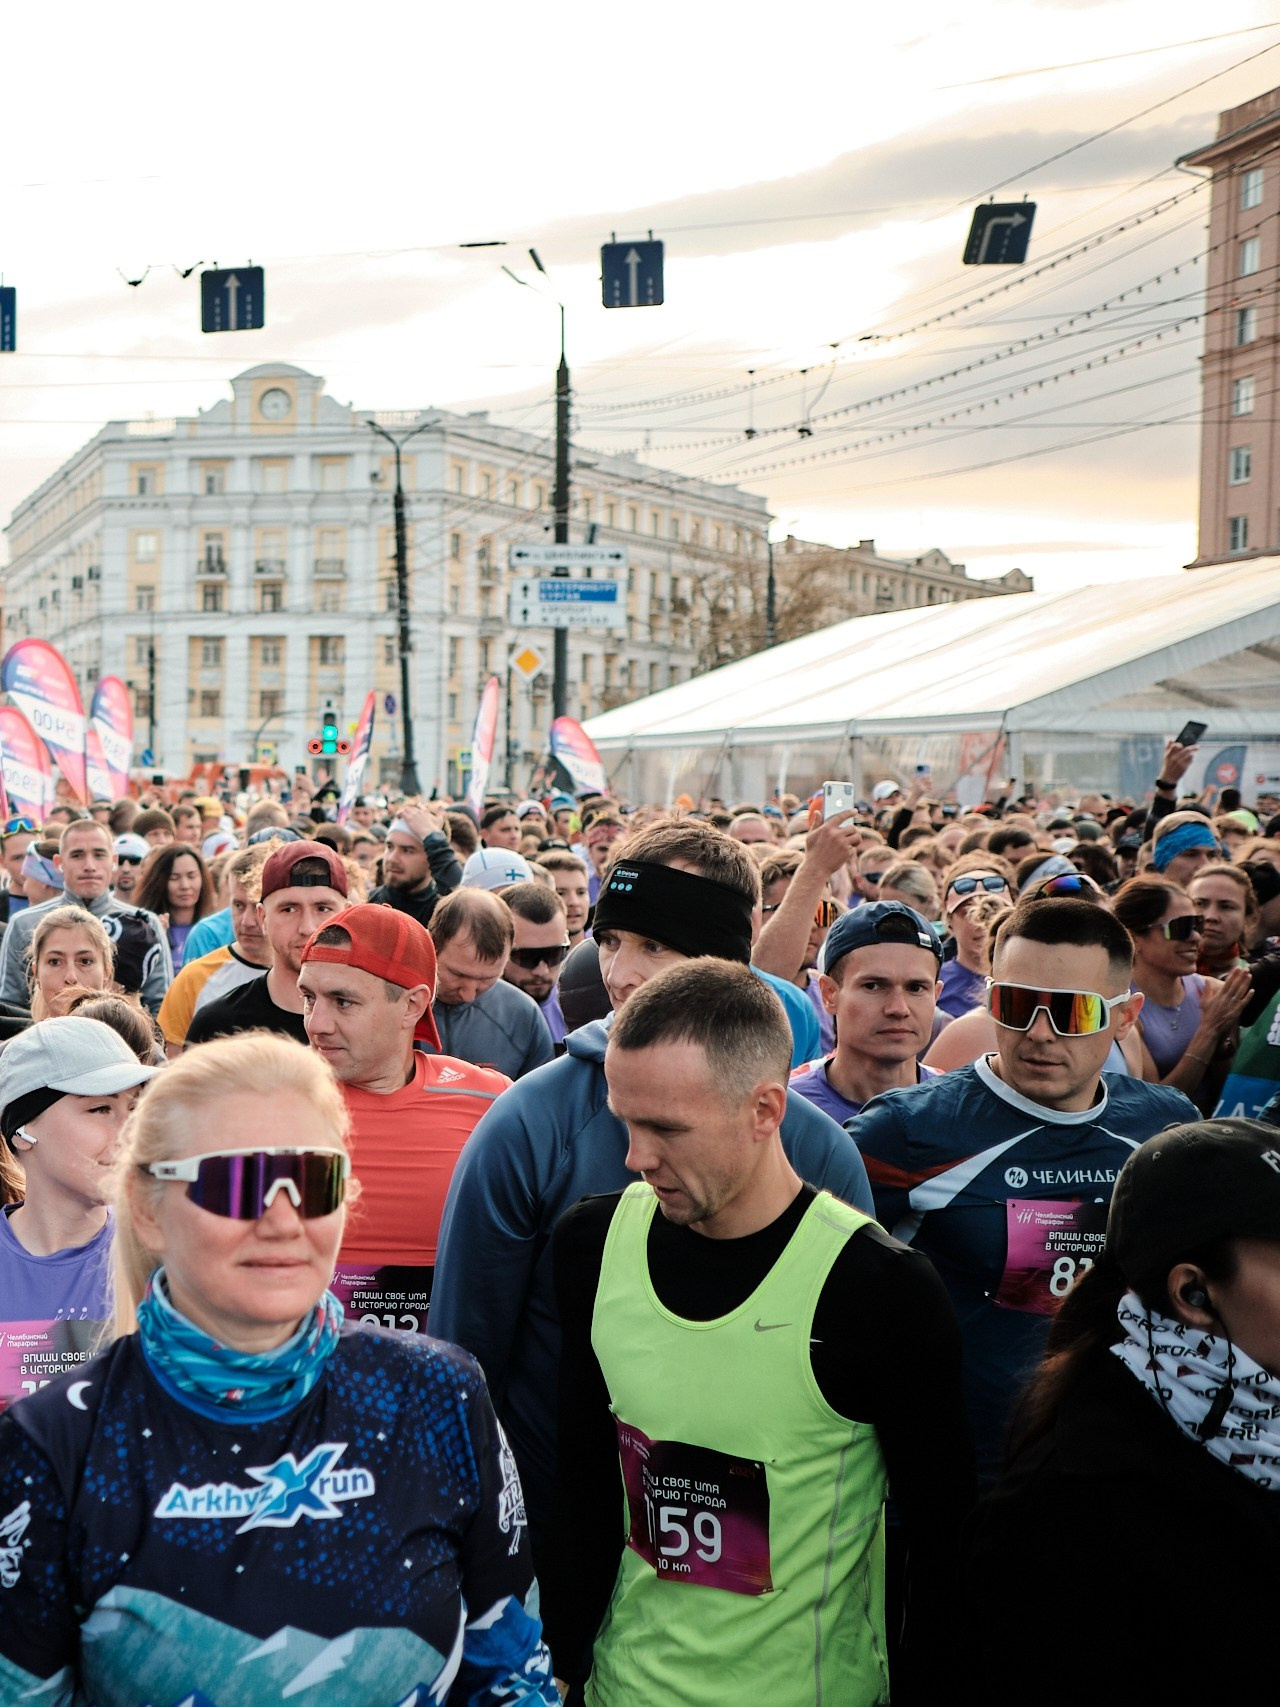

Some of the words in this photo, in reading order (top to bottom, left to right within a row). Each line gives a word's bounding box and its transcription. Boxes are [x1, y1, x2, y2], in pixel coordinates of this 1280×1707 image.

[1035, 1212, 1074, 1220] Челябинский
[1049, 1231, 1081, 1241] ВПИШИ
[1083, 1233, 1106, 1242] СВОЕ
[1045, 1242, 1052, 1251] В
[1054, 1243, 1096, 1252] ИСТОРИЮ
[353, 1291, 383, 1300] ВПИШИ
[385, 1292, 406, 1300] СВОЕ
[350, 1301, 356, 1309] В
[359, 1301, 397, 1310] ИСТОРИЮ
[23, 1353, 58, 1363] ВПИШИ
[61, 1352, 86, 1362] СВОЕ
[21, 1366, 26, 1375] В
[662, 1477, 691, 1489] СВОЕ
[694, 1480, 720, 1495] ИМЯ
[684, 1492, 727, 1509] ГОРОДА
[657, 1557, 668, 1570] 10
